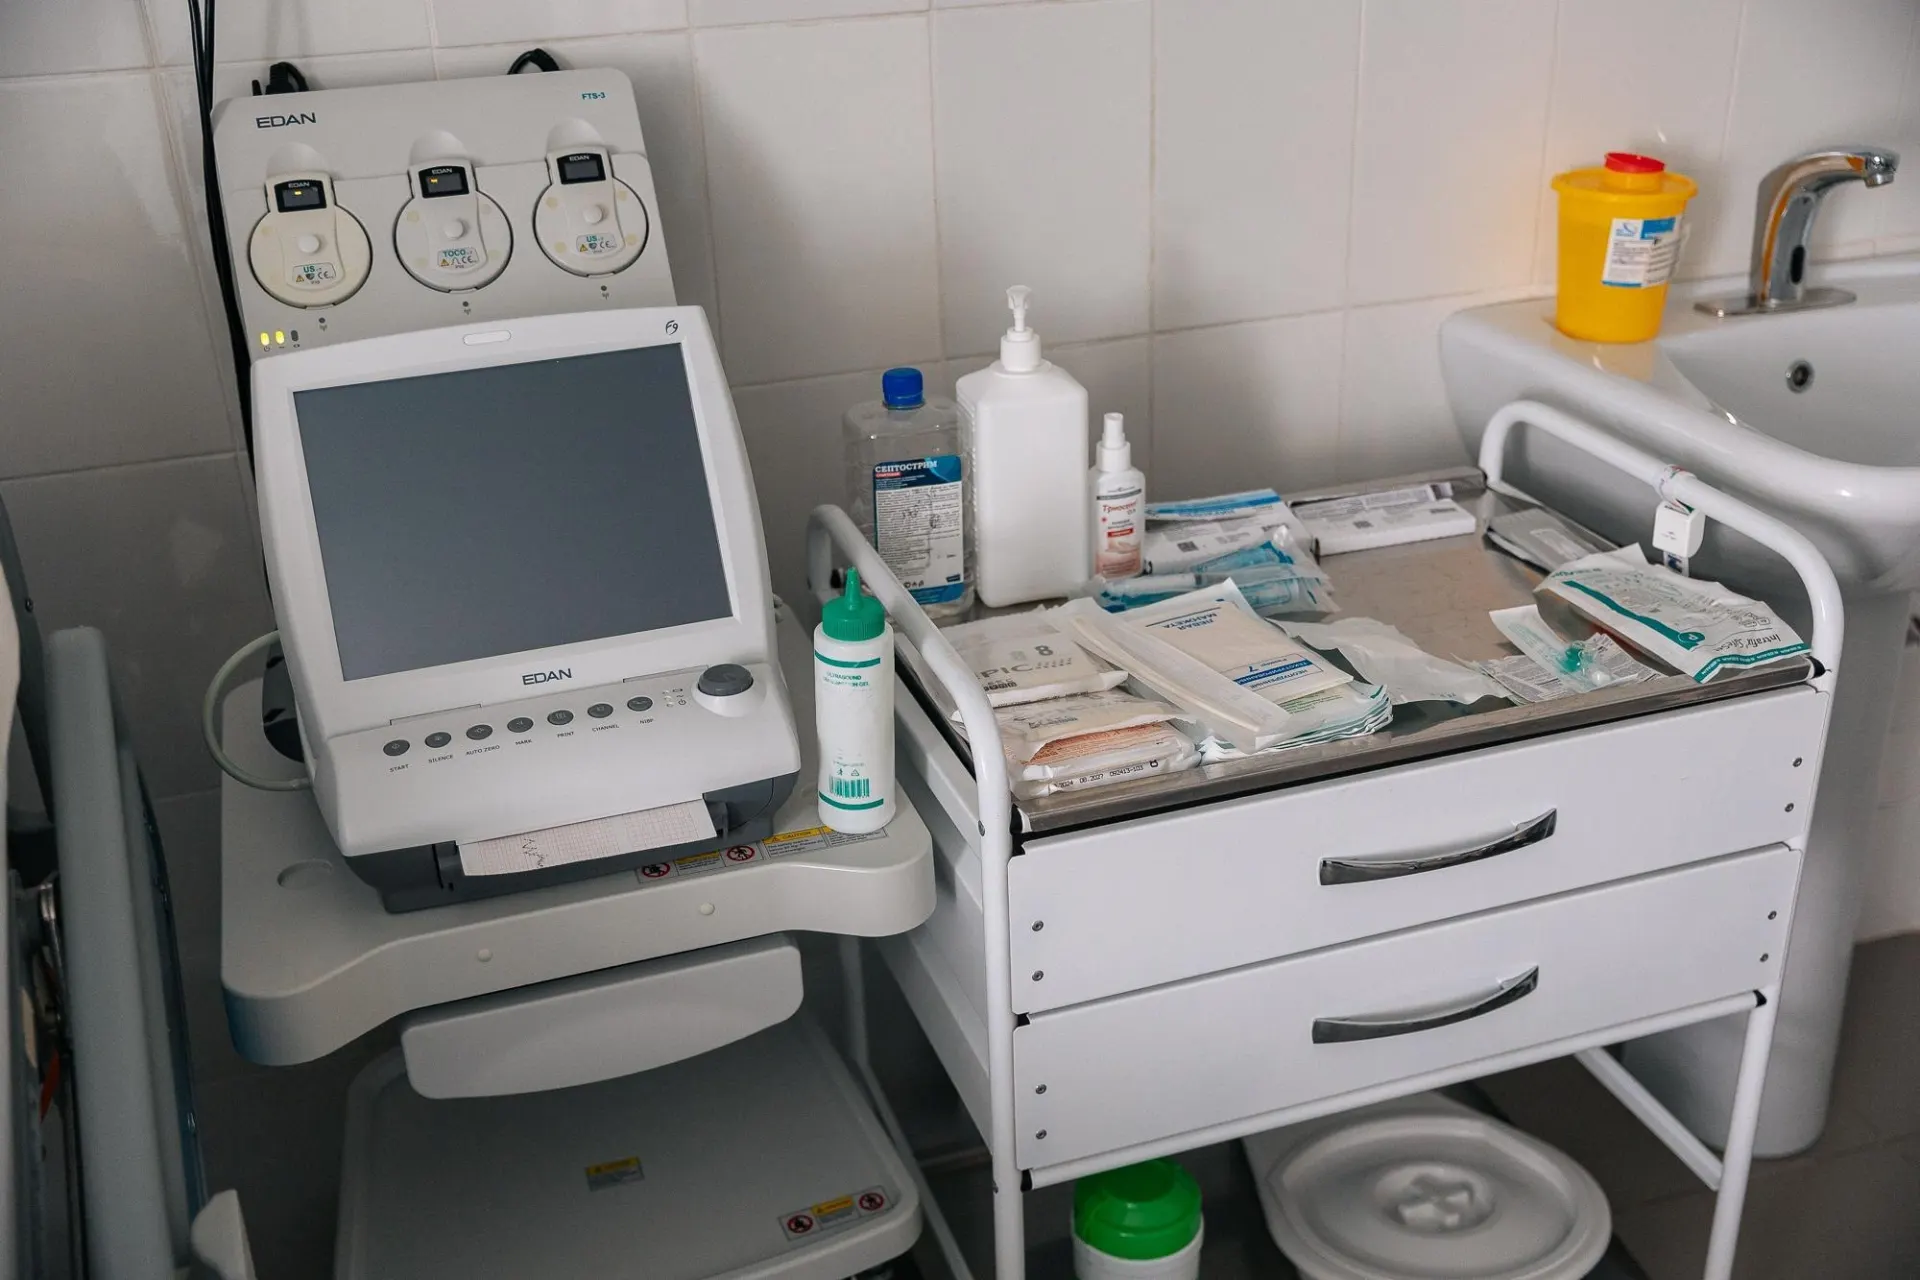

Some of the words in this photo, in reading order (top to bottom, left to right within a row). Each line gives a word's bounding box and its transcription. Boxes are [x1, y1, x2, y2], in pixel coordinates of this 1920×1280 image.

[582, 92, 606, 100] FTS-3
[256, 112, 317, 129] EDAN
[288, 181, 310, 189] EDAN
[443, 249, 466, 258] TOCO
[303, 265, 316, 273] US
[665, 319, 679, 335] F9
[875, 460, 938, 473] СЕПТОСТРИМ
[1034, 645, 1054, 656] 8
[522, 668, 572, 685] EDAN
[592, 724, 620, 732] CHANNEL
[465, 748, 483, 756] AUTO
[484, 744, 500, 753] ZERO
[428, 754, 454, 763] SILENCE
[389, 764, 409, 772] START
